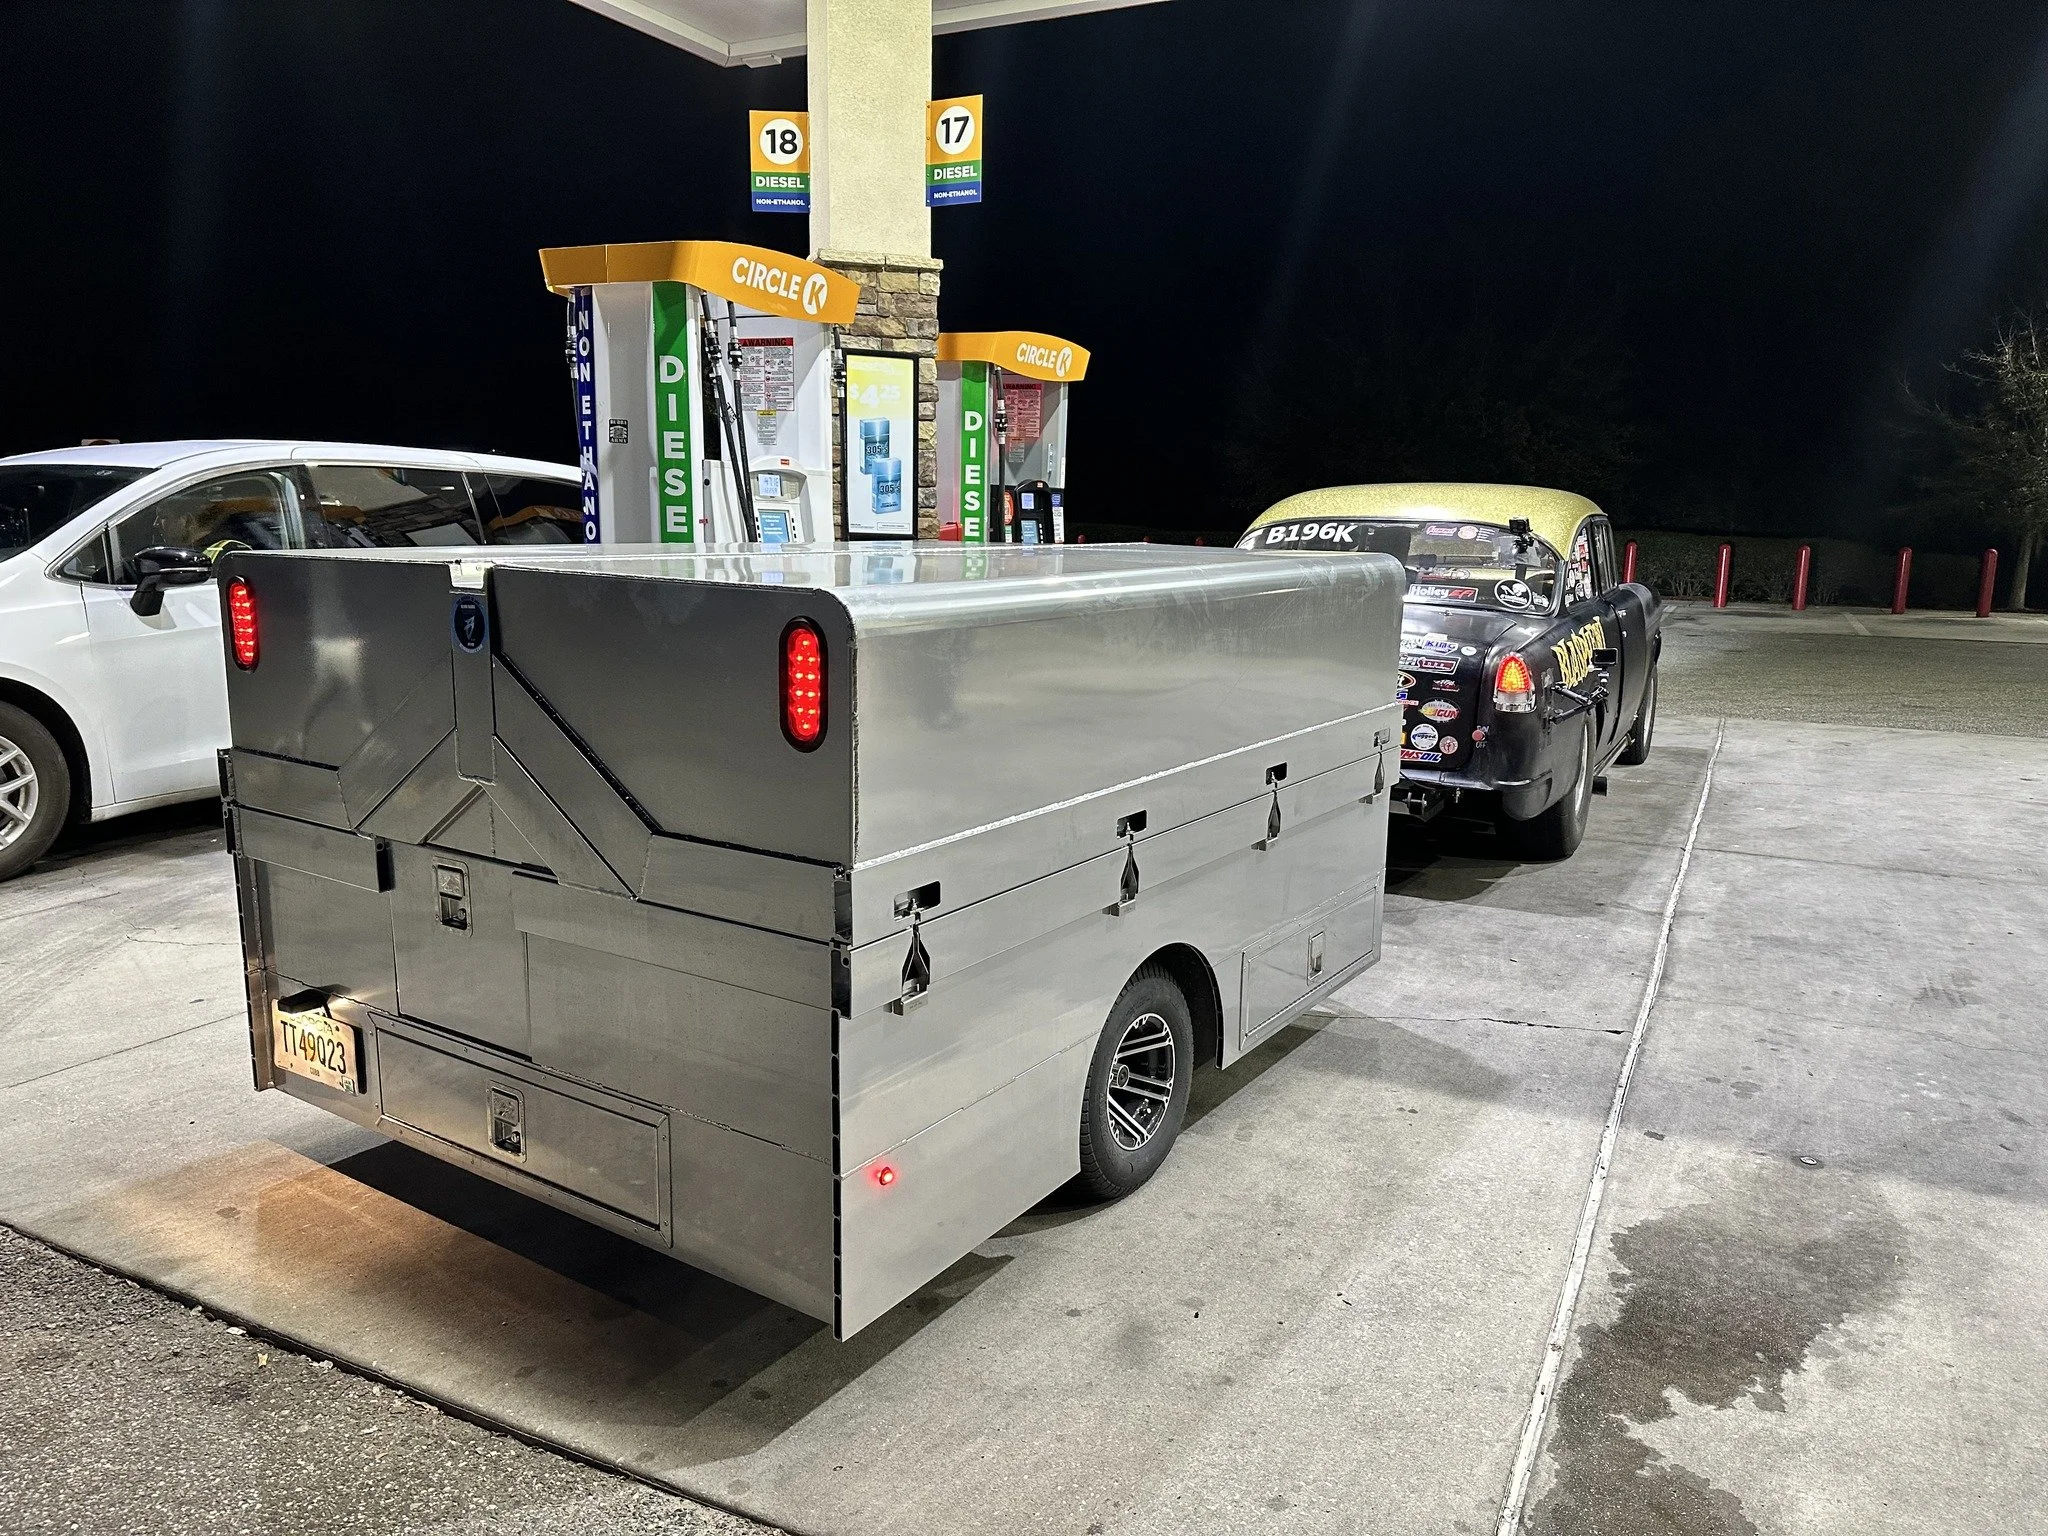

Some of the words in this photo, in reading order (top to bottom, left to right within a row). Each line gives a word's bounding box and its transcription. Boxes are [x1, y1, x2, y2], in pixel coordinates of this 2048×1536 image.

[765, 129, 798, 154] 18
[941, 116, 969, 144] 17
[755, 176, 805, 188] DIESEL
[934, 165, 977, 180] DIESEL
[756, 198, 805, 206] NON-ETHANOL
[933, 189, 977, 199] NON-ETHANOL
[732, 257, 802, 300] CIRCLE
[805, 276, 827, 314] K
[579, 311, 590, 382] NON
[1016, 342, 1057, 369] CIRCLE
[1057, 349, 1071, 376] K
[659, 355, 687, 543] DIESE
[582, 395, 597, 541] ETHANO
[964, 410, 983, 542] DIESE
[1265, 522, 1358, 545] B196K
[1410, 585, 1450, 599] Holley
